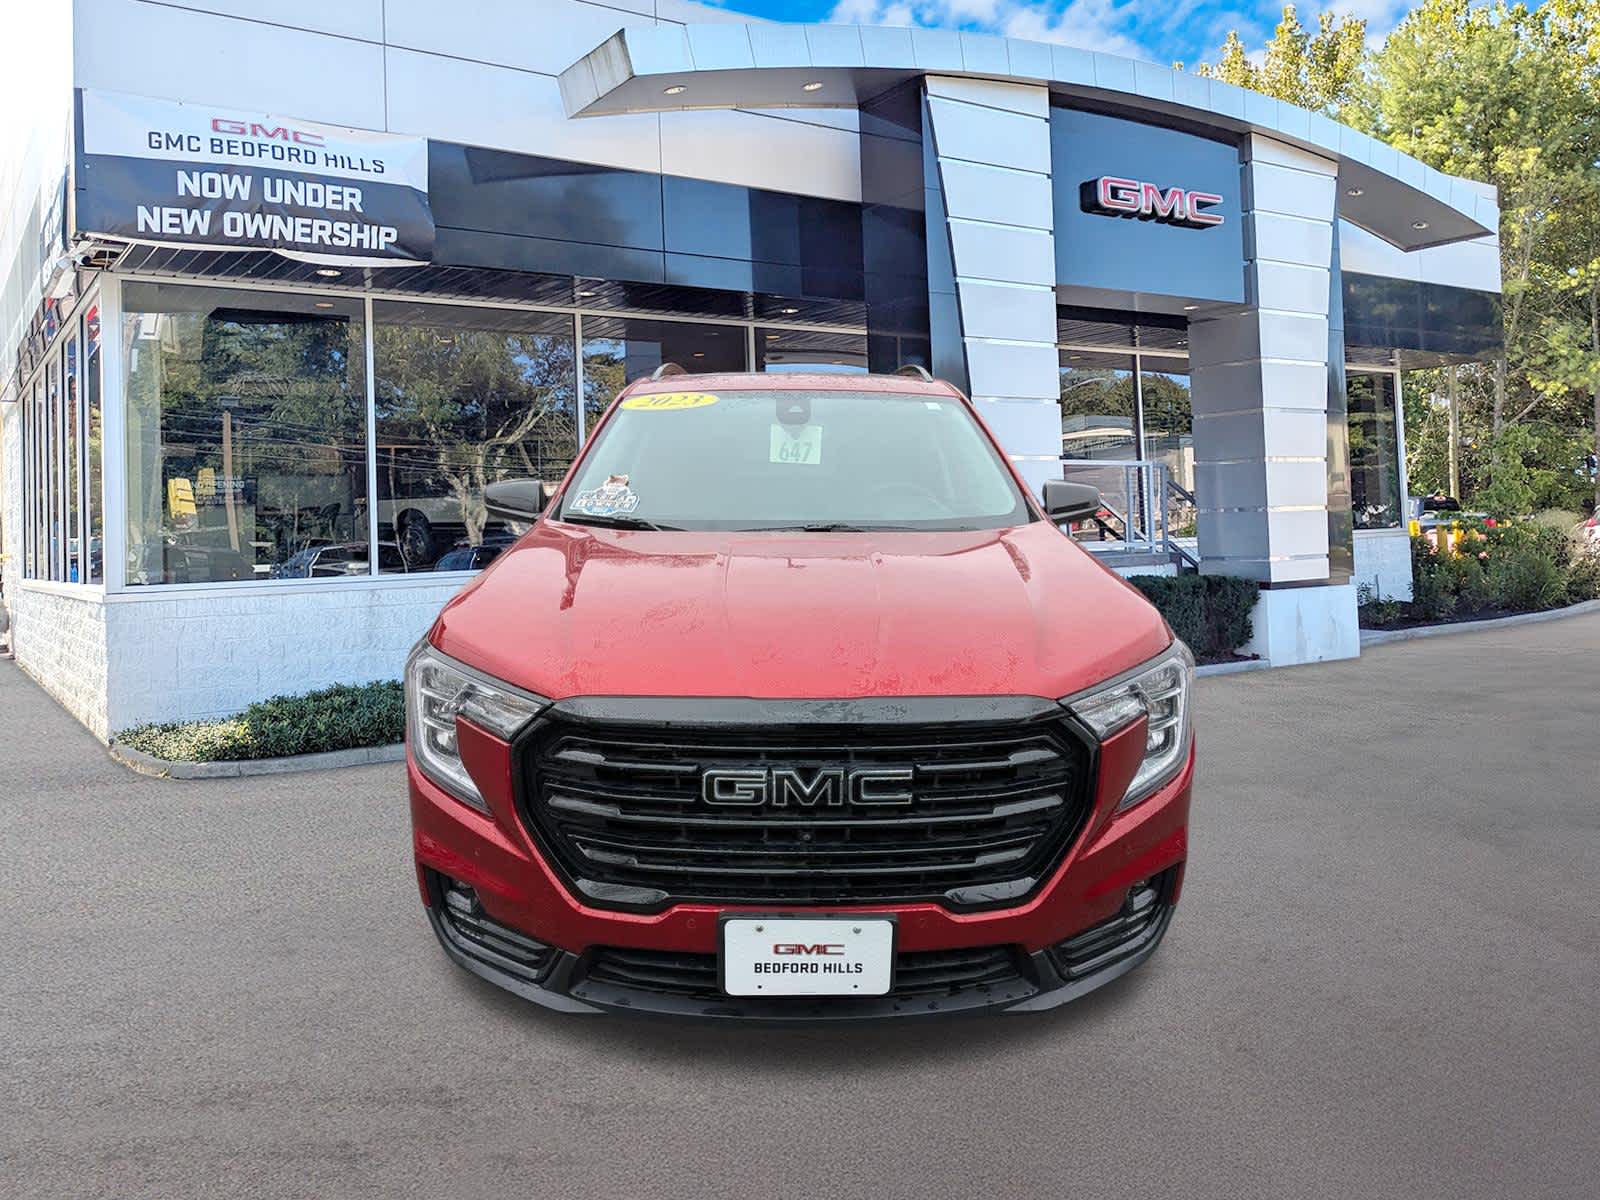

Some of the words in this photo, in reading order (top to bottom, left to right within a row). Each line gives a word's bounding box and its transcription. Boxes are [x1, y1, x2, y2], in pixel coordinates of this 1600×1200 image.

[211, 118, 325, 147] GMC
[148, 131, 201, 153] GMC
[210, 138, 316, 165] BEDFORD
[325, 154, 385, 174] HILLS
[176, 170, 252, 201] NOW
[263, 178, 363, 213] UNDER
[1099, 175, 1225, 224] GMC
[137, 206, 211, 236] NEW
[224, 211, 398, 250] OWNERSHIP
[780, 441, 812, 461] 647
[703, 769, 913, 806] GMC
[754, 963, 818, 974] BEDFORD
[823, 962, 863, 974] HILLS
[773, 944, 845, 955] GMC
